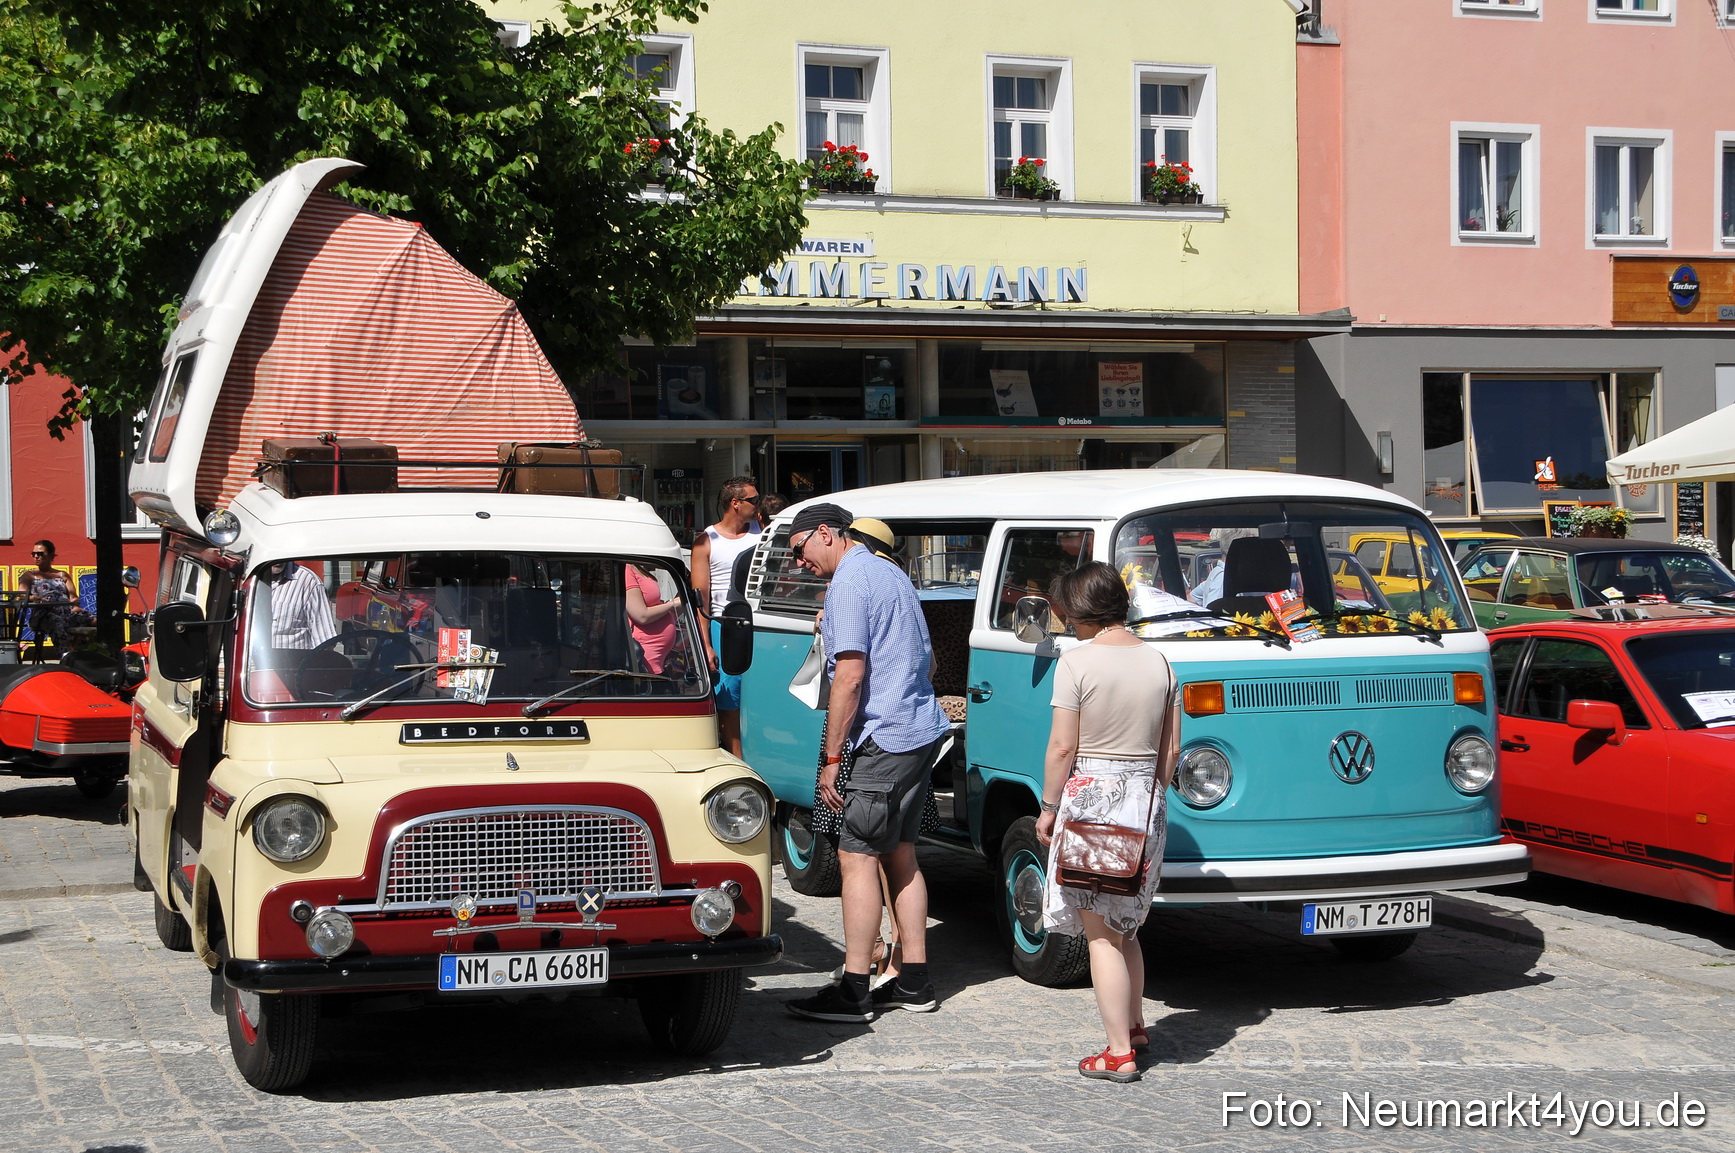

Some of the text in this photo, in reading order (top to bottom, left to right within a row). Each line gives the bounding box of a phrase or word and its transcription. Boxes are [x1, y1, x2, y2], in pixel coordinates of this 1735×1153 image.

[1672, 282, 1698, 290] Tucher
[1721, 308, 1735, 318] CA
[1066, 417, 1092, 425] Metabo
[1625, 462, 1680, 480] Tucher
[1537, 483, 1558, 491] PEPE
[413, 725, 579, 738] BEDFORD
[1526, 821, 1647, 857] PORSCHE
[1305, 900, 1430, 930] D NM T 278H
[445, 953, 604, 985] D NM CA 668H
